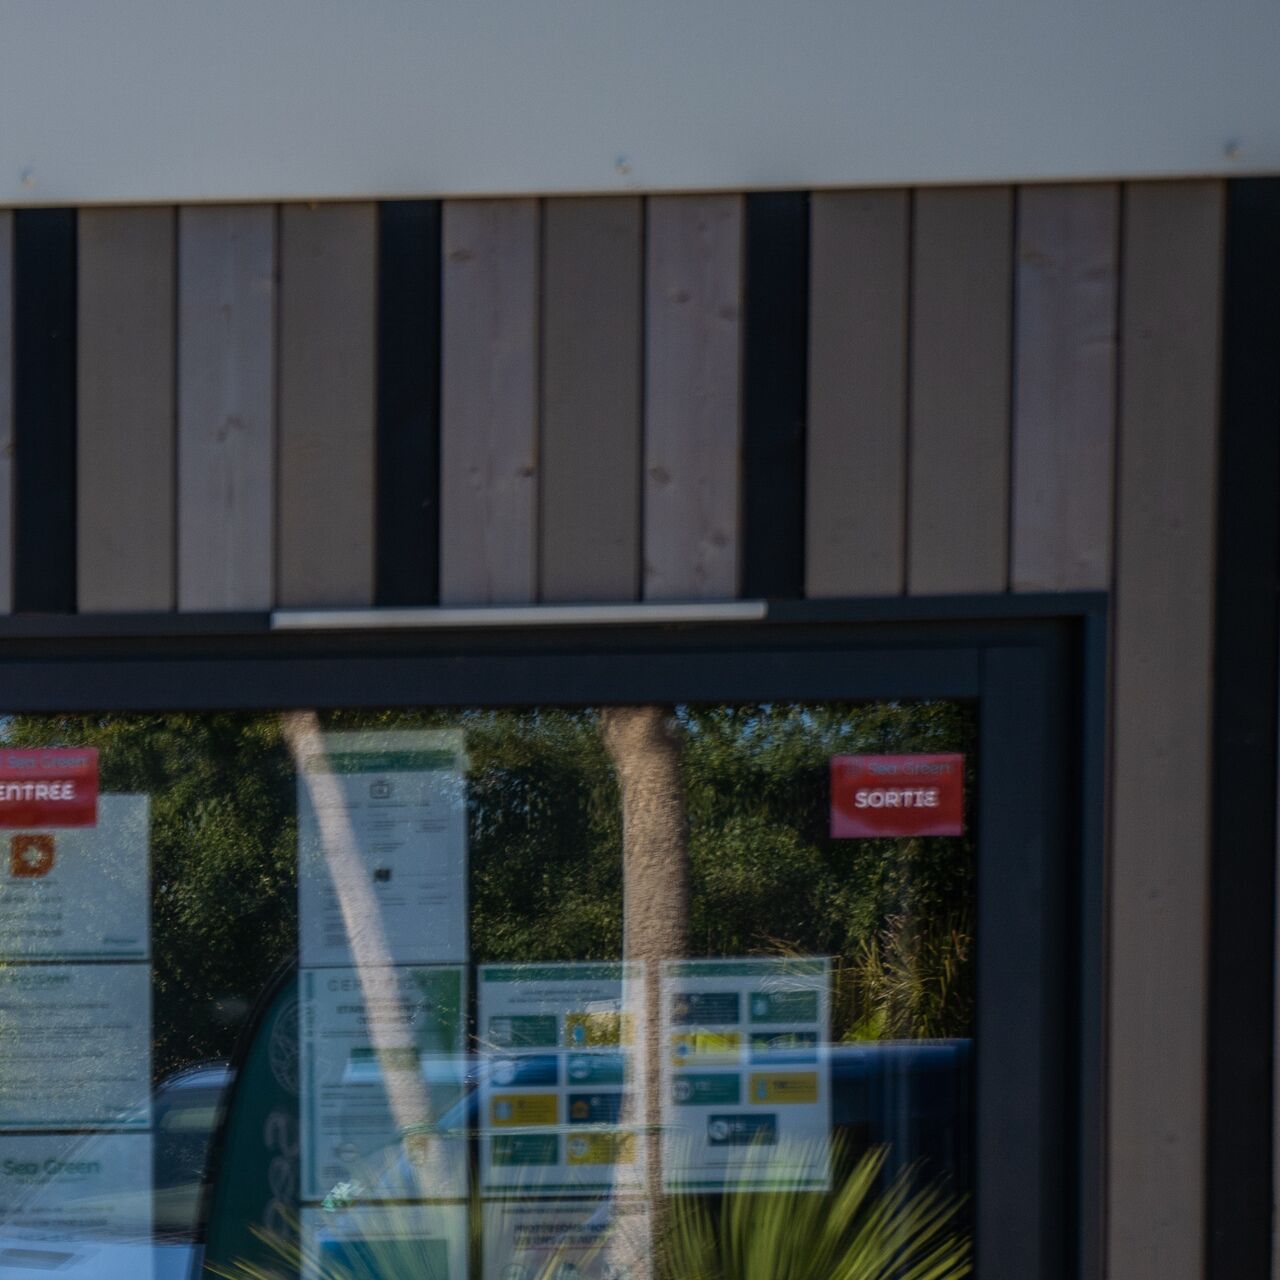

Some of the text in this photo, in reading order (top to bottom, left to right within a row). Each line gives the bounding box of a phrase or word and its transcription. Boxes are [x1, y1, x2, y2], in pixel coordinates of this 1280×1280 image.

[854, 788, 939, 808] SORTIE
[2, 1157, 102, 1176] Sea Green
